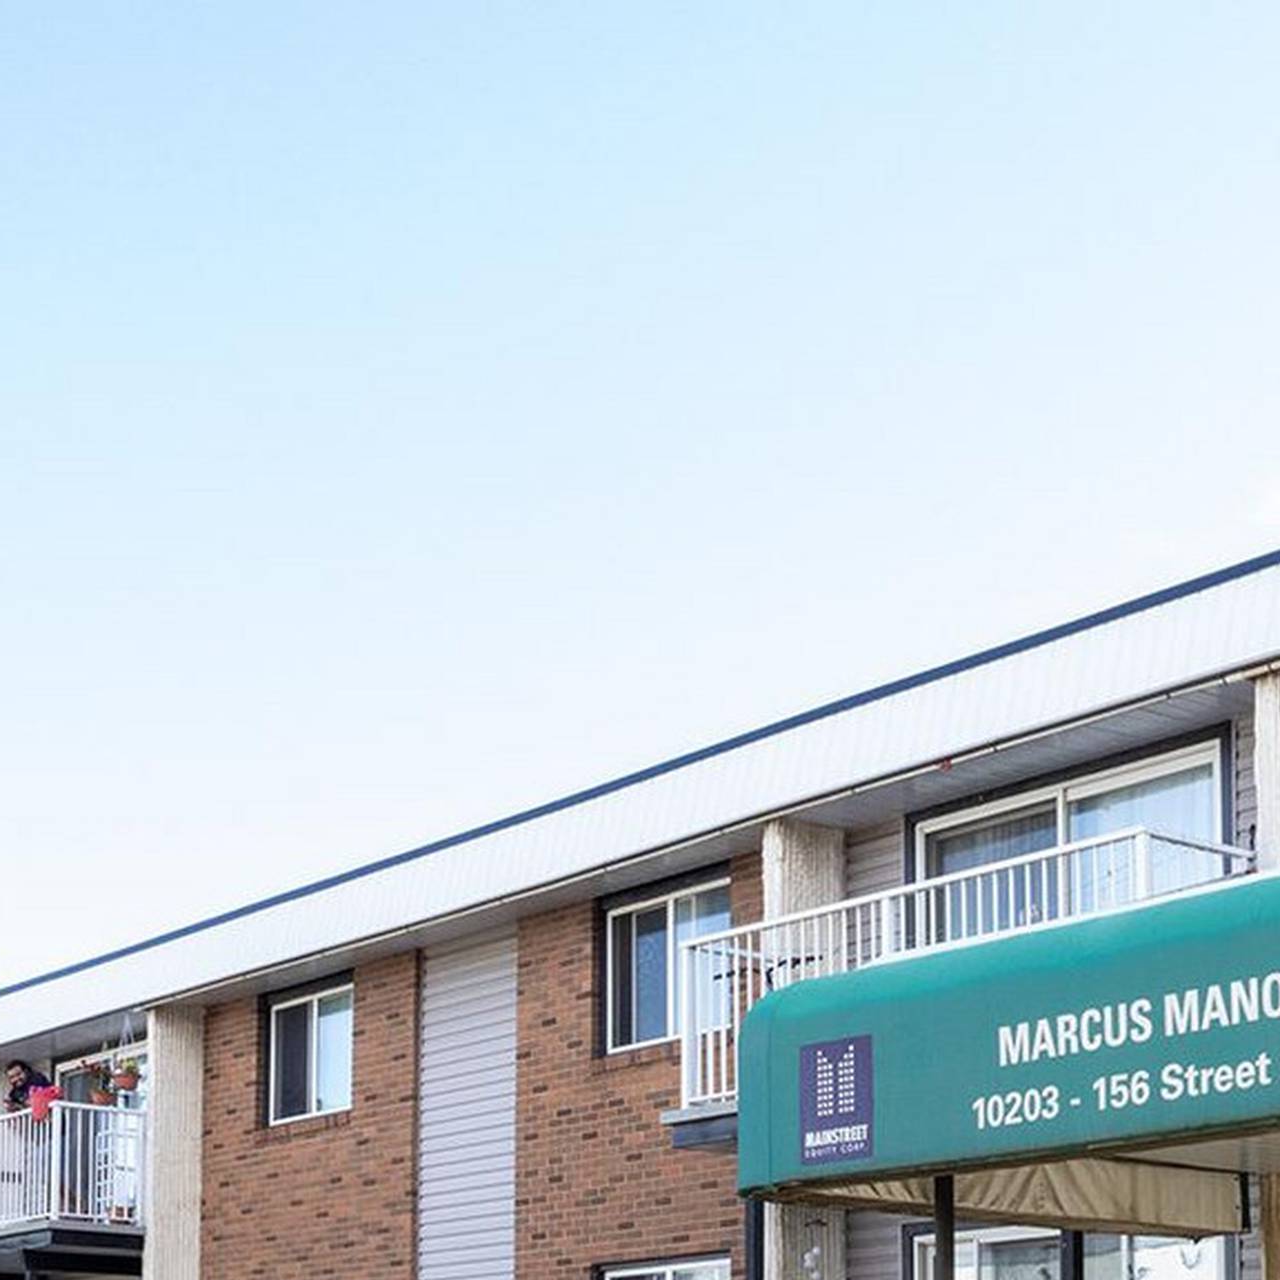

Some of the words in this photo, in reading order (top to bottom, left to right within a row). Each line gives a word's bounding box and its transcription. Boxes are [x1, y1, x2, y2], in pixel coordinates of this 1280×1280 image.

[997, 999, 1153, 1067] MARCUS
[972, 1084, 1060, 1130] 10203
[1092, 1069, 1151, 1111] 156
[1160, 1051, 1272, 1102] Street
[805, 1124, 868, 1147] MAINSTREET
